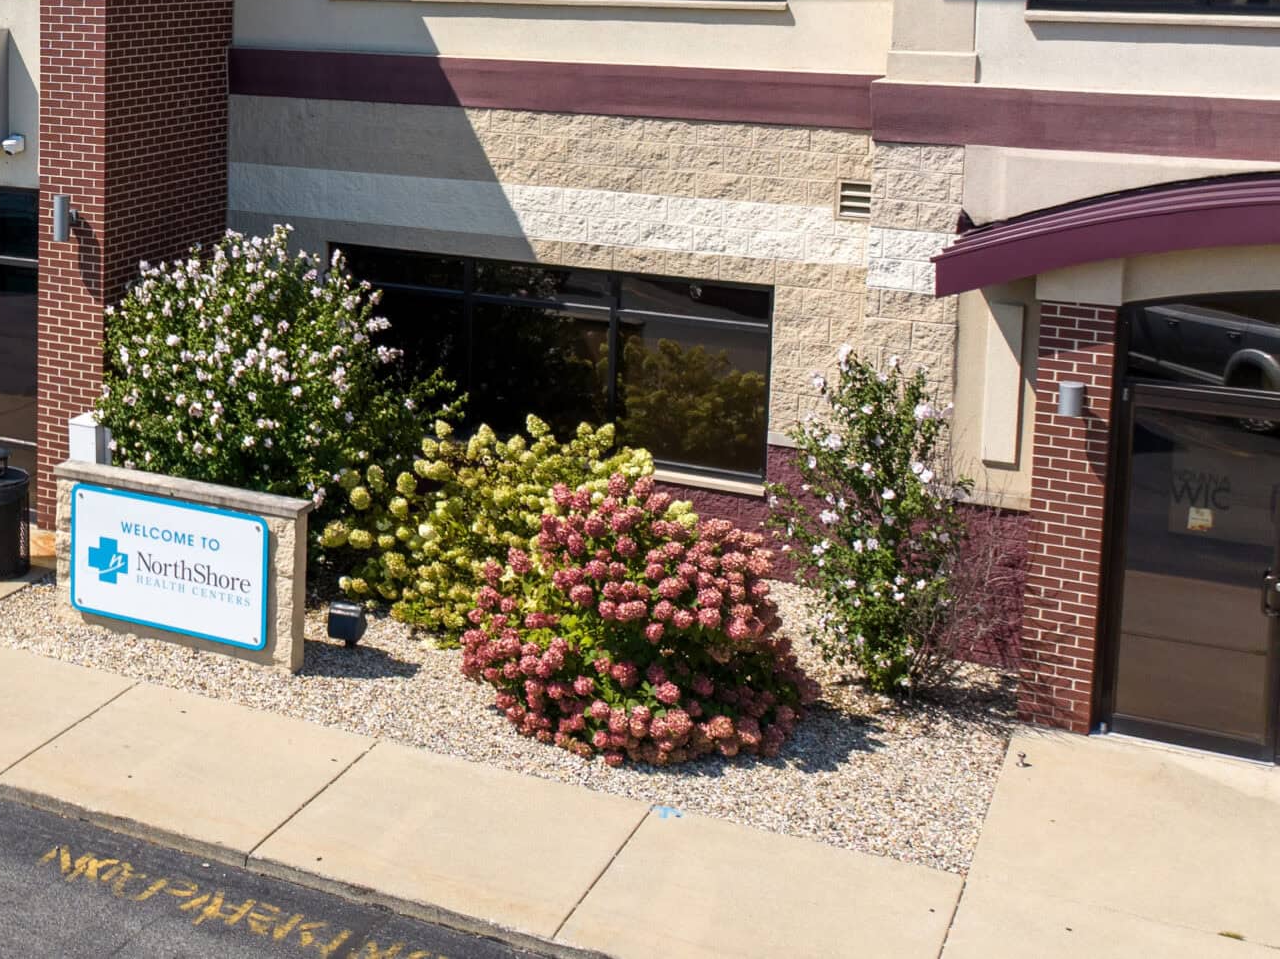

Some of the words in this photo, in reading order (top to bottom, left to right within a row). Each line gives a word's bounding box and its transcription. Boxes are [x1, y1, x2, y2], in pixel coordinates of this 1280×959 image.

[1170, 481, 1231, 511] WIC
[121, 521, 195, 547] WELCOME
[201, 536, 221, 553] TO
[136, 551, 252, 594] NorthShore
[136, 575, 186, 594] HEALTH
[192, 586, 252, 608] CENTERS
